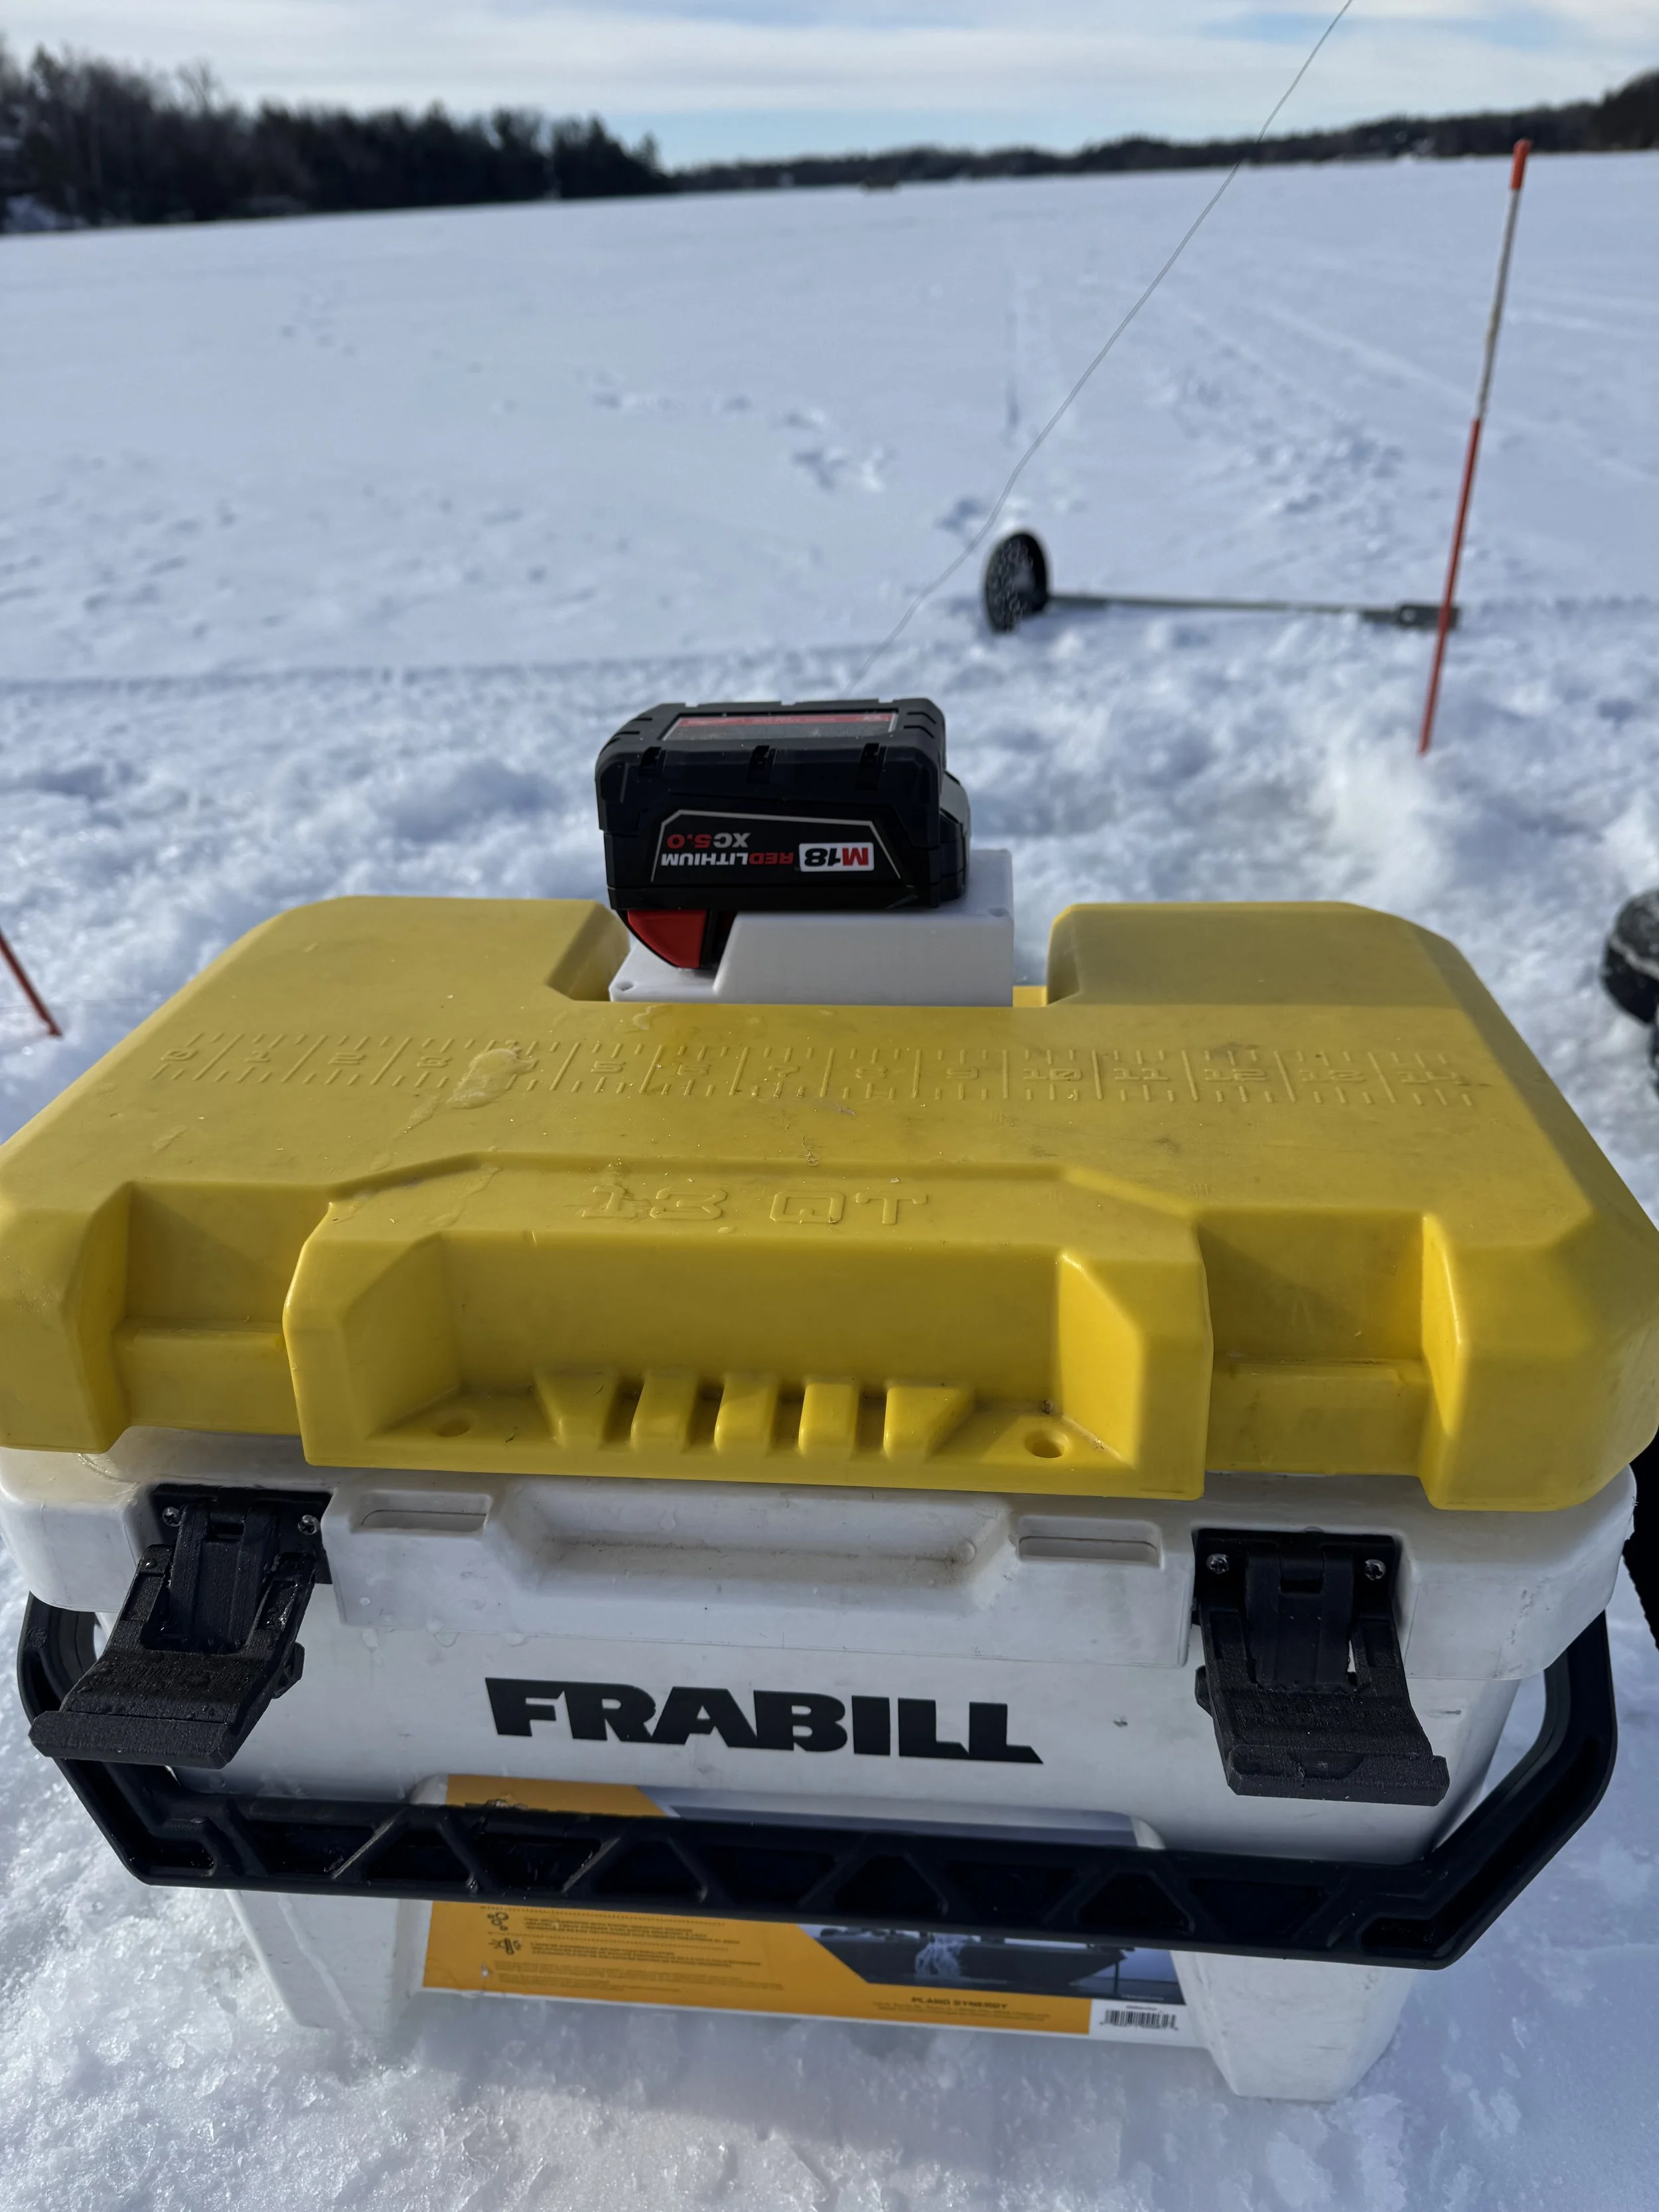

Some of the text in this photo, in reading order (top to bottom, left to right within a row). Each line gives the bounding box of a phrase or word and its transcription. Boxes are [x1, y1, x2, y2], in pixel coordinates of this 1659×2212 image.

[666, 832, 751, 849] XC5.0
[661, 847, 869, 867] M18 REDLITHIUM
[767, 1065, 800, 1078] 7
[855, 1066, 888, 1080] 8
[946, 1067, 979, 1080] 9
[1023, 1068, 1082, 1081] 10
[1113, 1068, 1170, 1082] 11
[1204, 1068, 1267, 1083] 12
[1299, 1069, 1366, 1083] 13
[582, 1185, 929, 1225] 13 QT
[485, 1677, 1044, 1764] FRABILL
